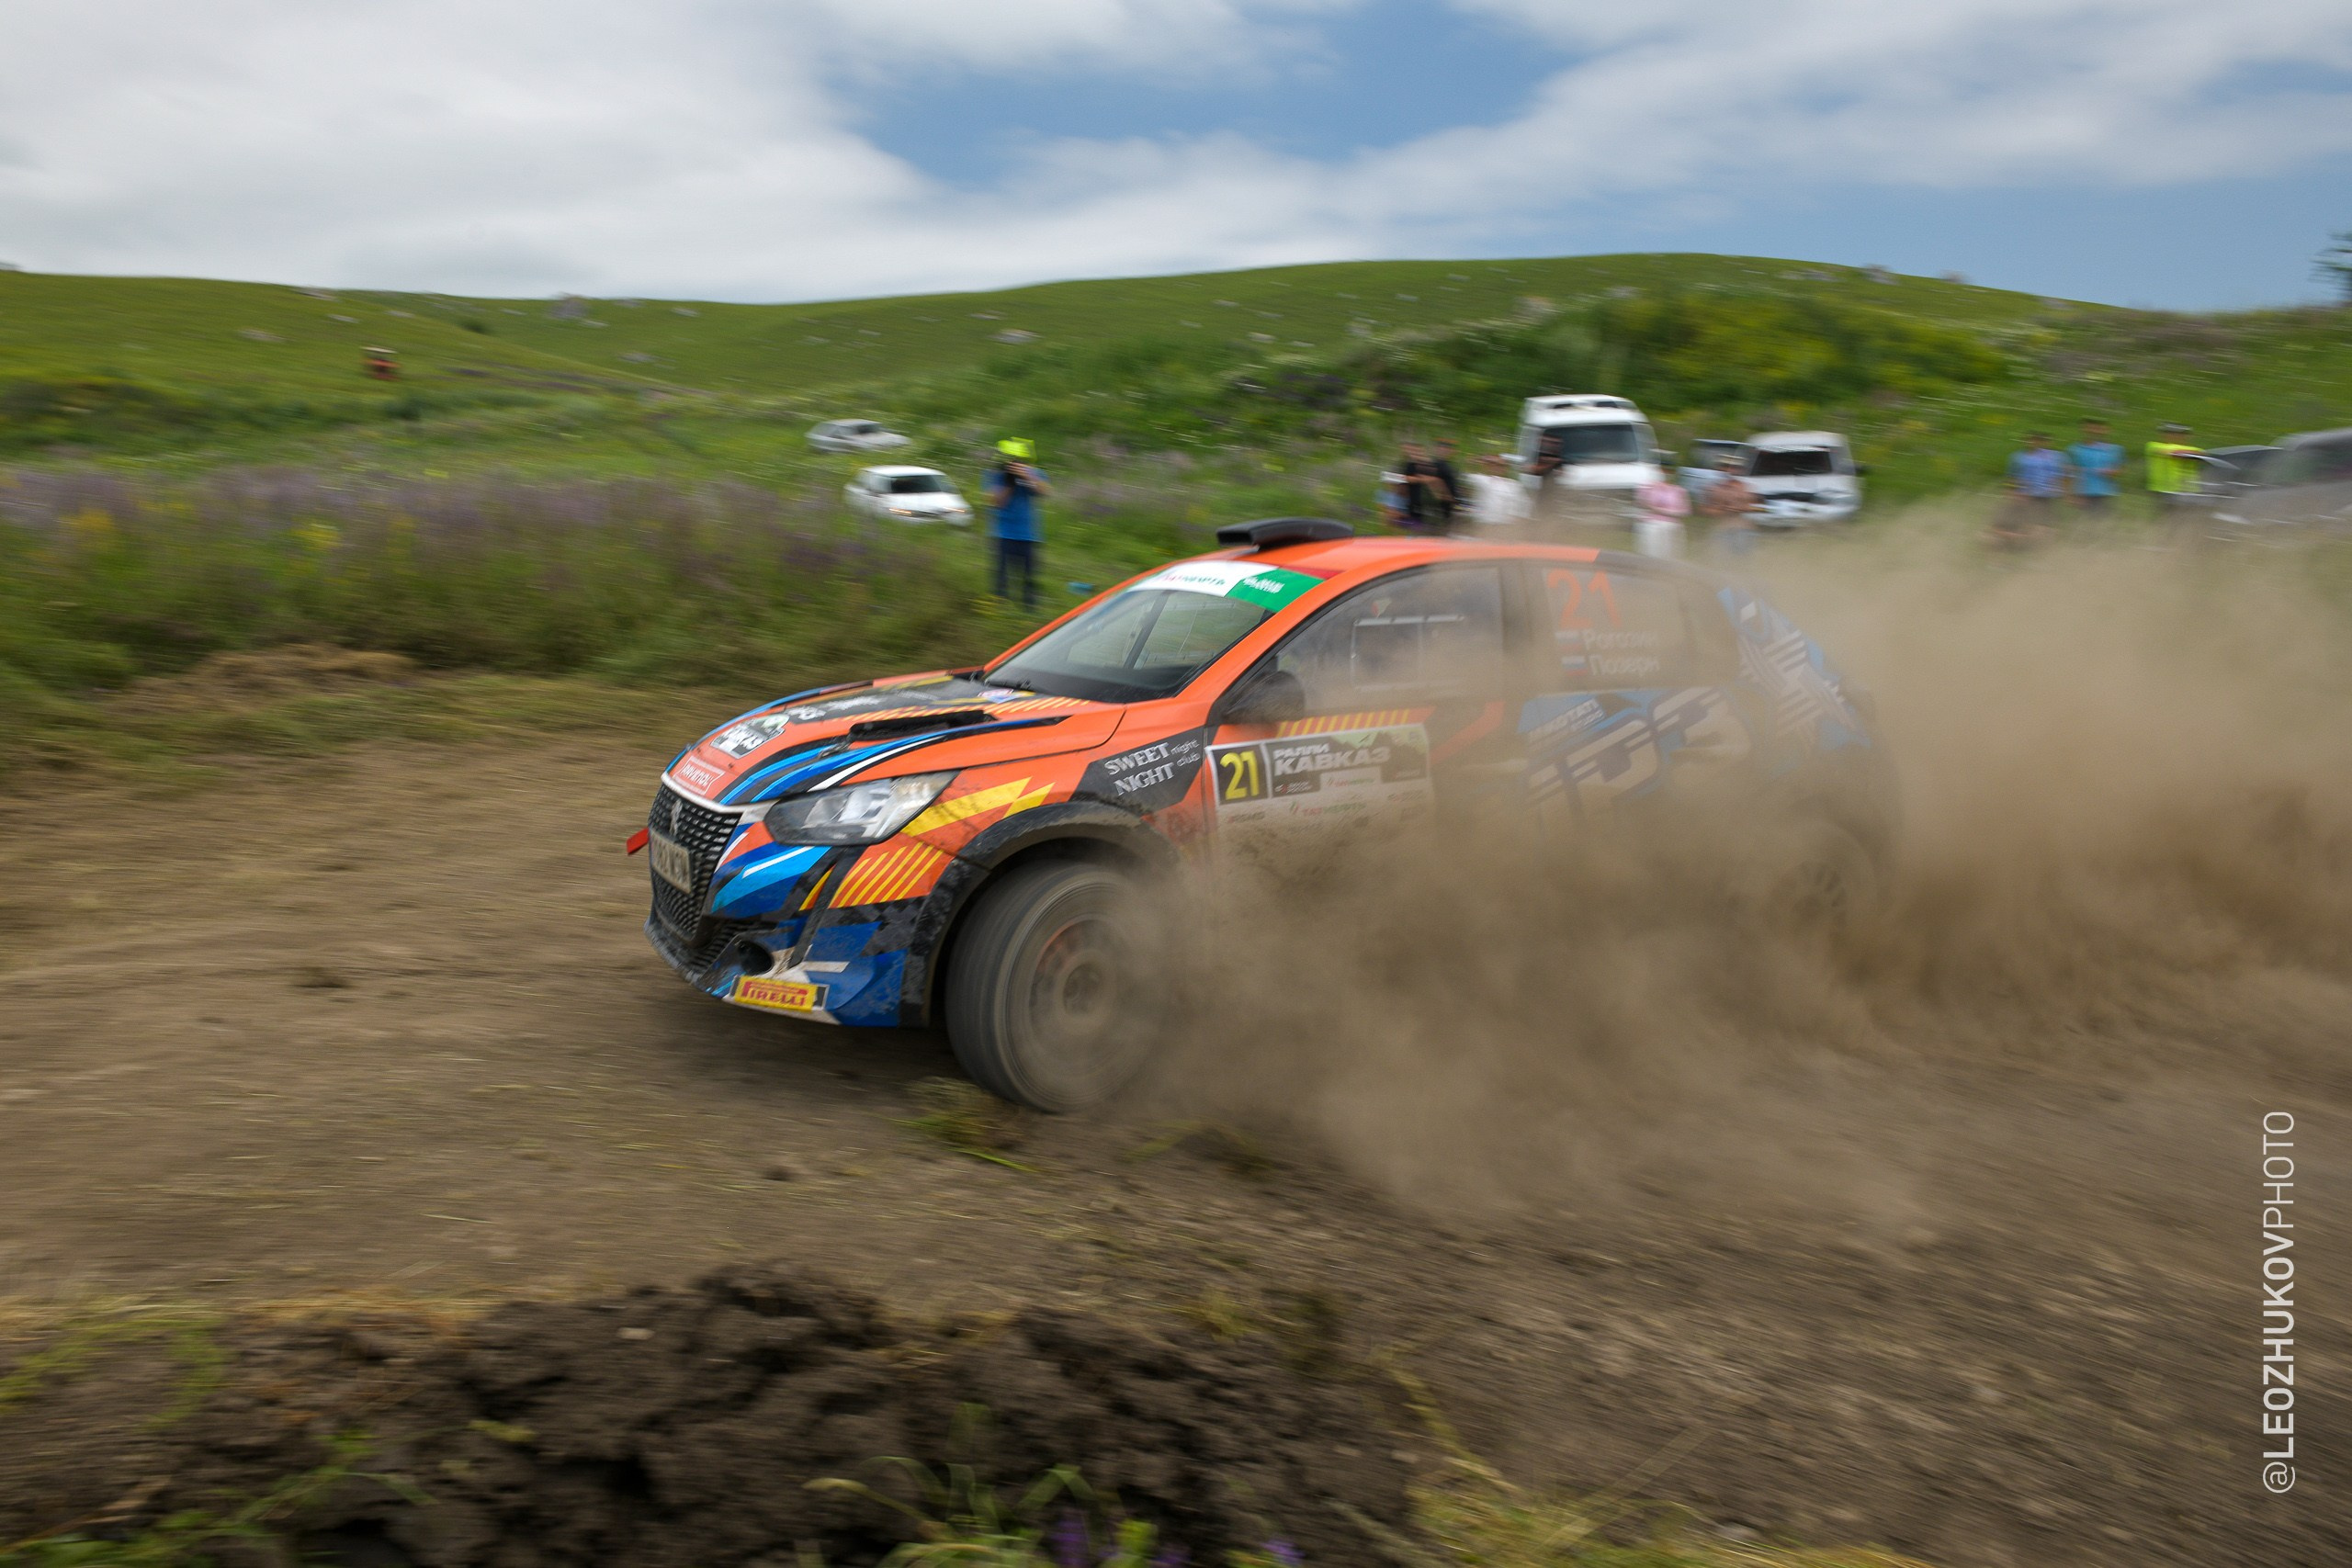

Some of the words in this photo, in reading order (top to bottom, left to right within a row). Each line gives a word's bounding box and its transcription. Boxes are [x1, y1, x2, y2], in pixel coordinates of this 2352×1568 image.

[1546, 568, 1622, 628] 21
[1104, 742, 1169, 775] SWEET
[1170, 739, 1200, 756] night
[1272, 743, 1329, 760] РАЛЛИ
[1273, 747, 1391, 777] КАВКАЗ
[1114, 762, 1174, 795] NIGHT
[1177, 752, 1201, 767] club
[1220, 750, 1260, 800] 21
[741, 981, 808, 1007] PIRELLI
